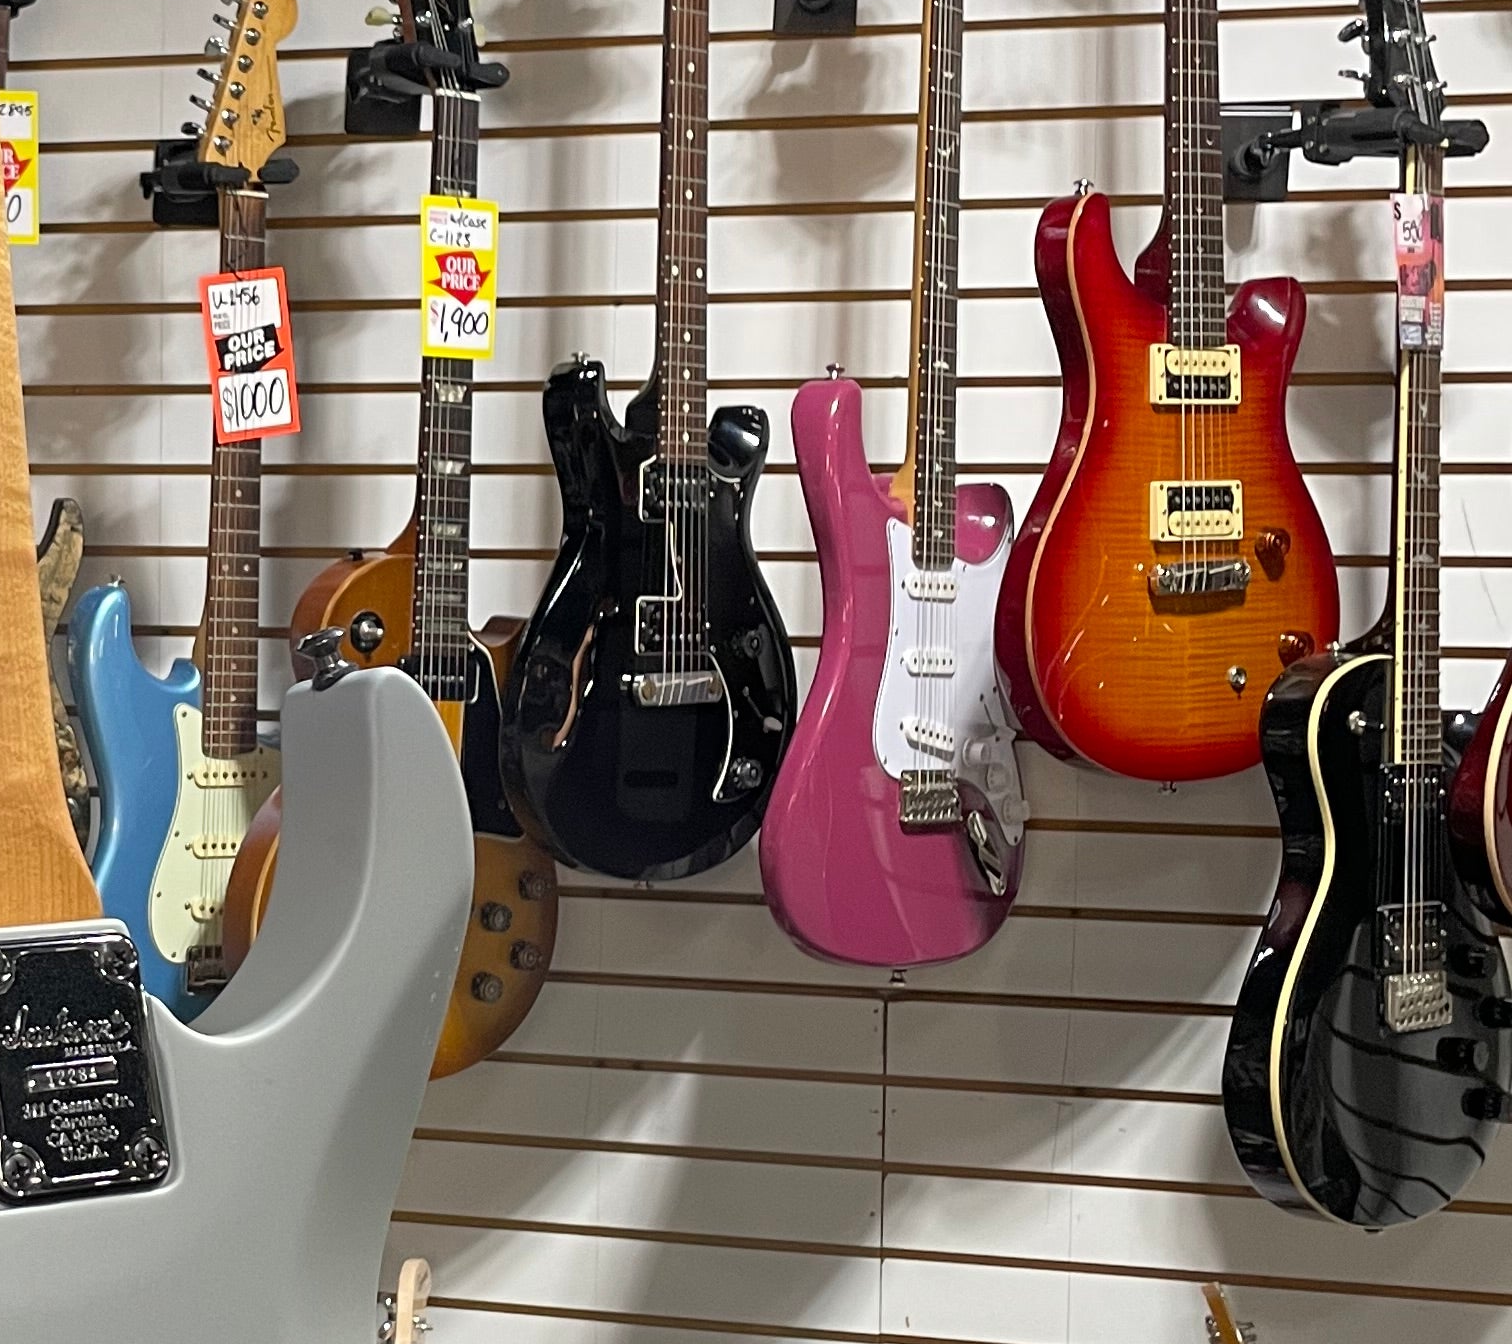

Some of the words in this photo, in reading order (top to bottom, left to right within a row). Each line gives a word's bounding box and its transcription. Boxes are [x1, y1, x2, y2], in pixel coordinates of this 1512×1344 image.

[445, 255, 477, 274] OUR
[441, 271, 482, 292] PRICE
[227, 328, 266, 353] OUR
[223, 340, 277, 371] PRICE
[222, 376, 285, 428] $1000
